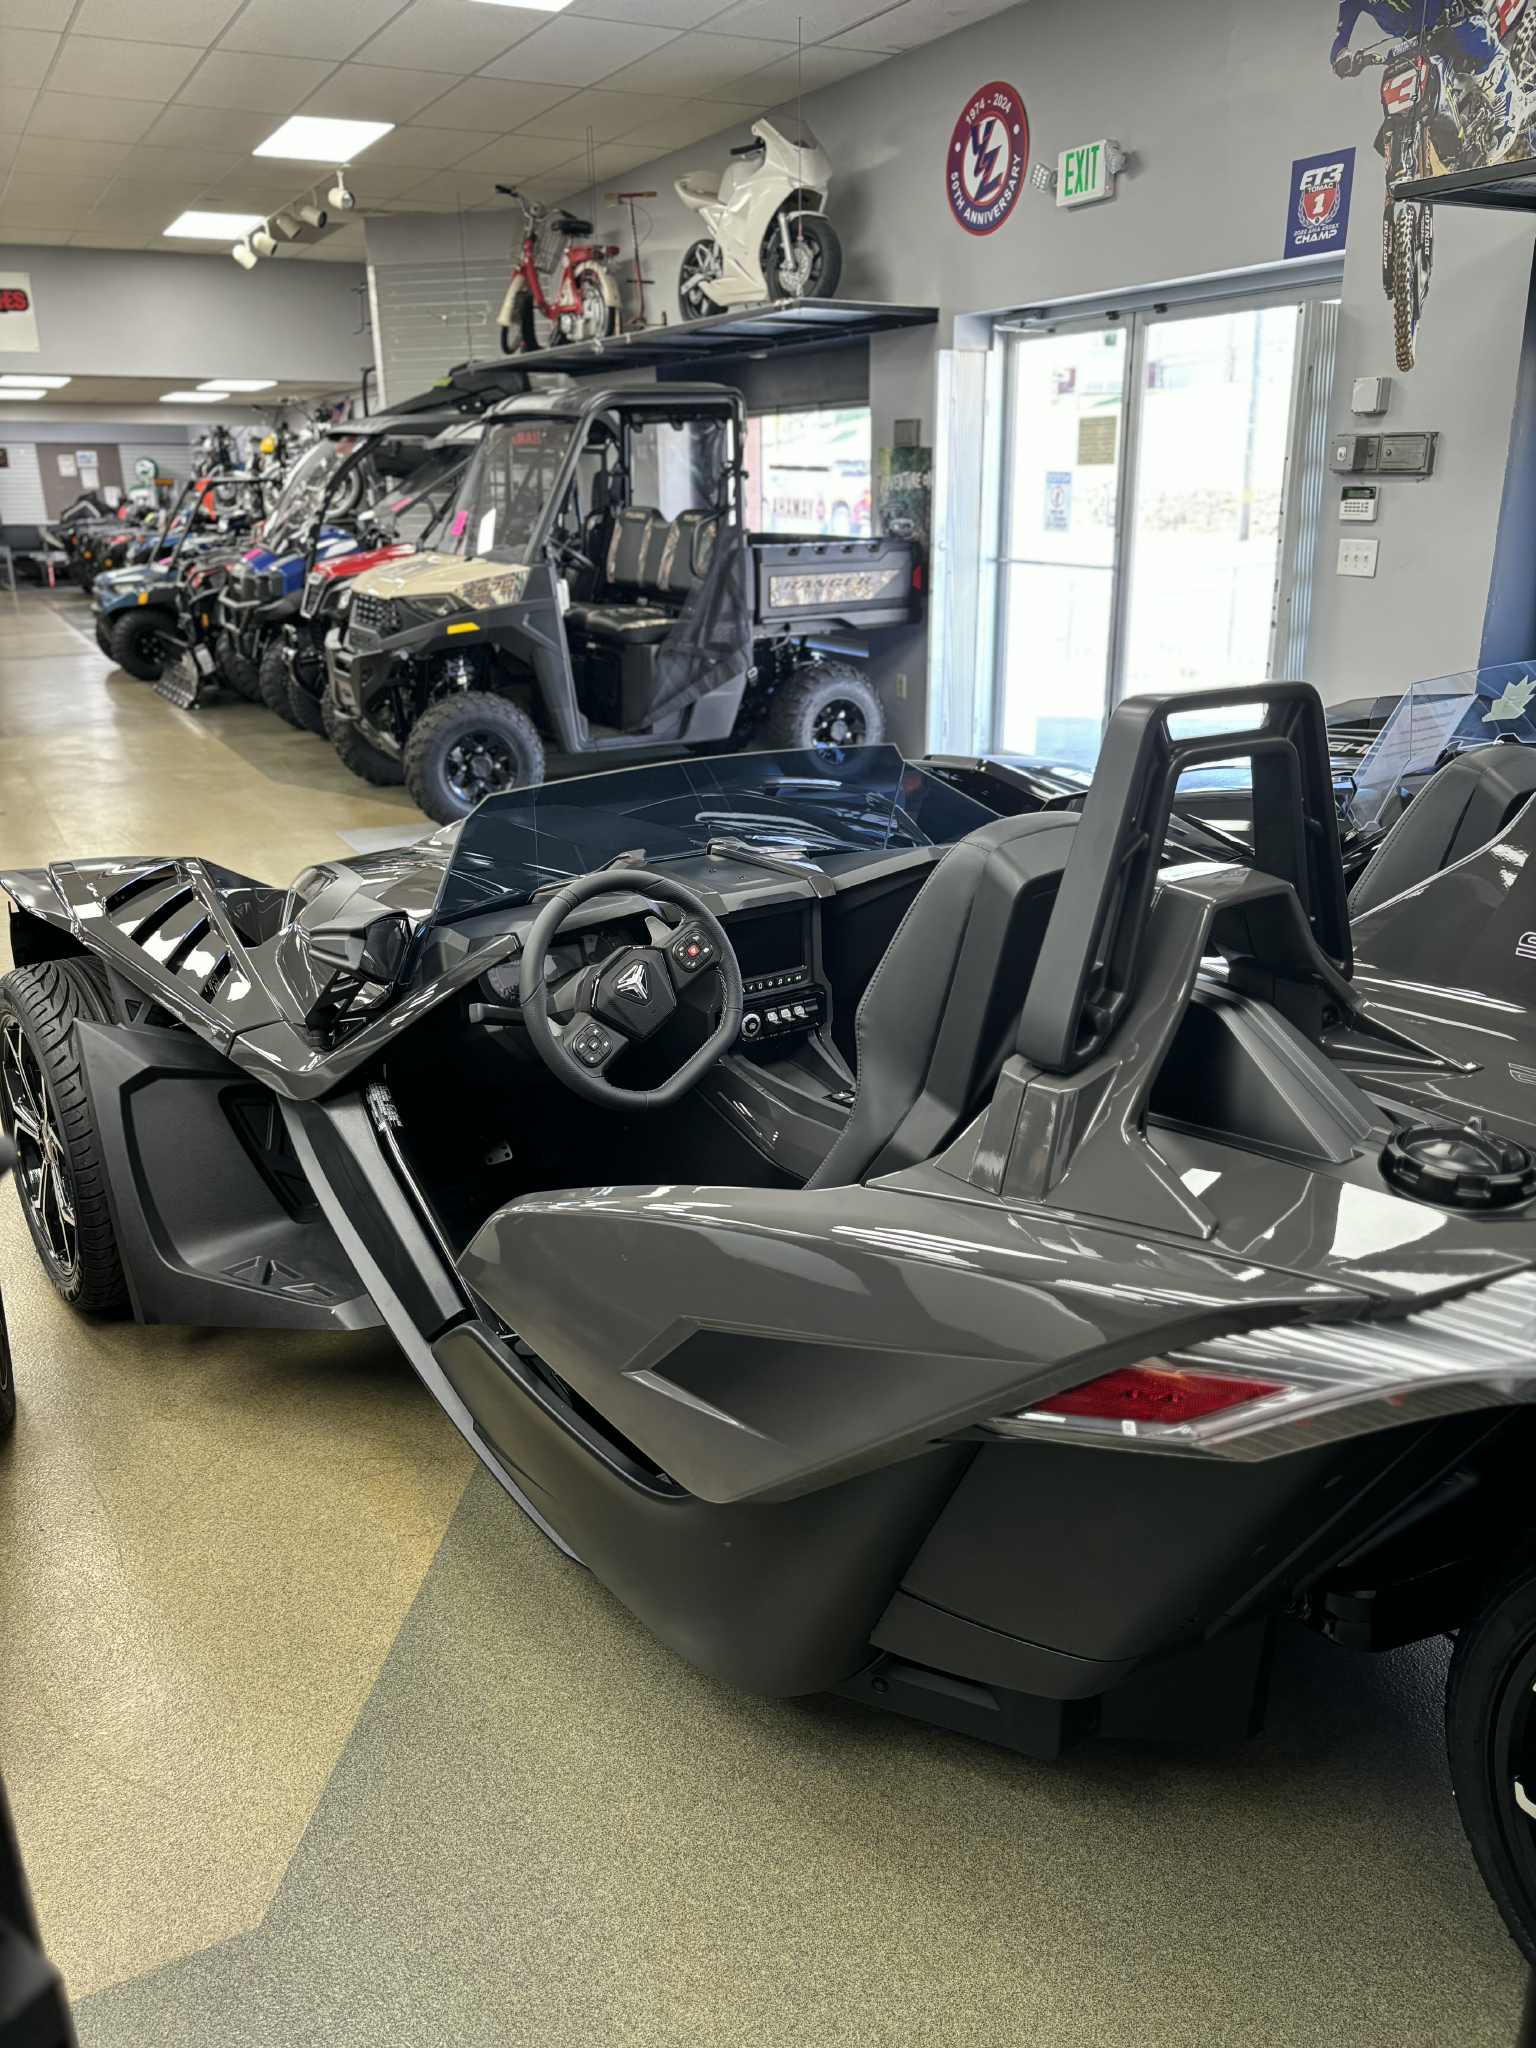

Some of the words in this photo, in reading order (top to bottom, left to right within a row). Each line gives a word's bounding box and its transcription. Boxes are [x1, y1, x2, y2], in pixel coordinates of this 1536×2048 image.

[965, 97, 986, 125] 1974
[993, 93, 1012, 115] 2024
[1063, 144, 1101, 198] EXIT
[1300, 163, 1345, 191] ET3
[951, 171, 965, 211] 50TH
[963, 153, 1022, 226] ANNIVERSARY
[1308, 182, 1334, 194] TOMAC
[1312, 193, 1326, 215] 1
[1294, 229, 1338, 245] CHAMP
[783, 576, 872, 590] RANGER
